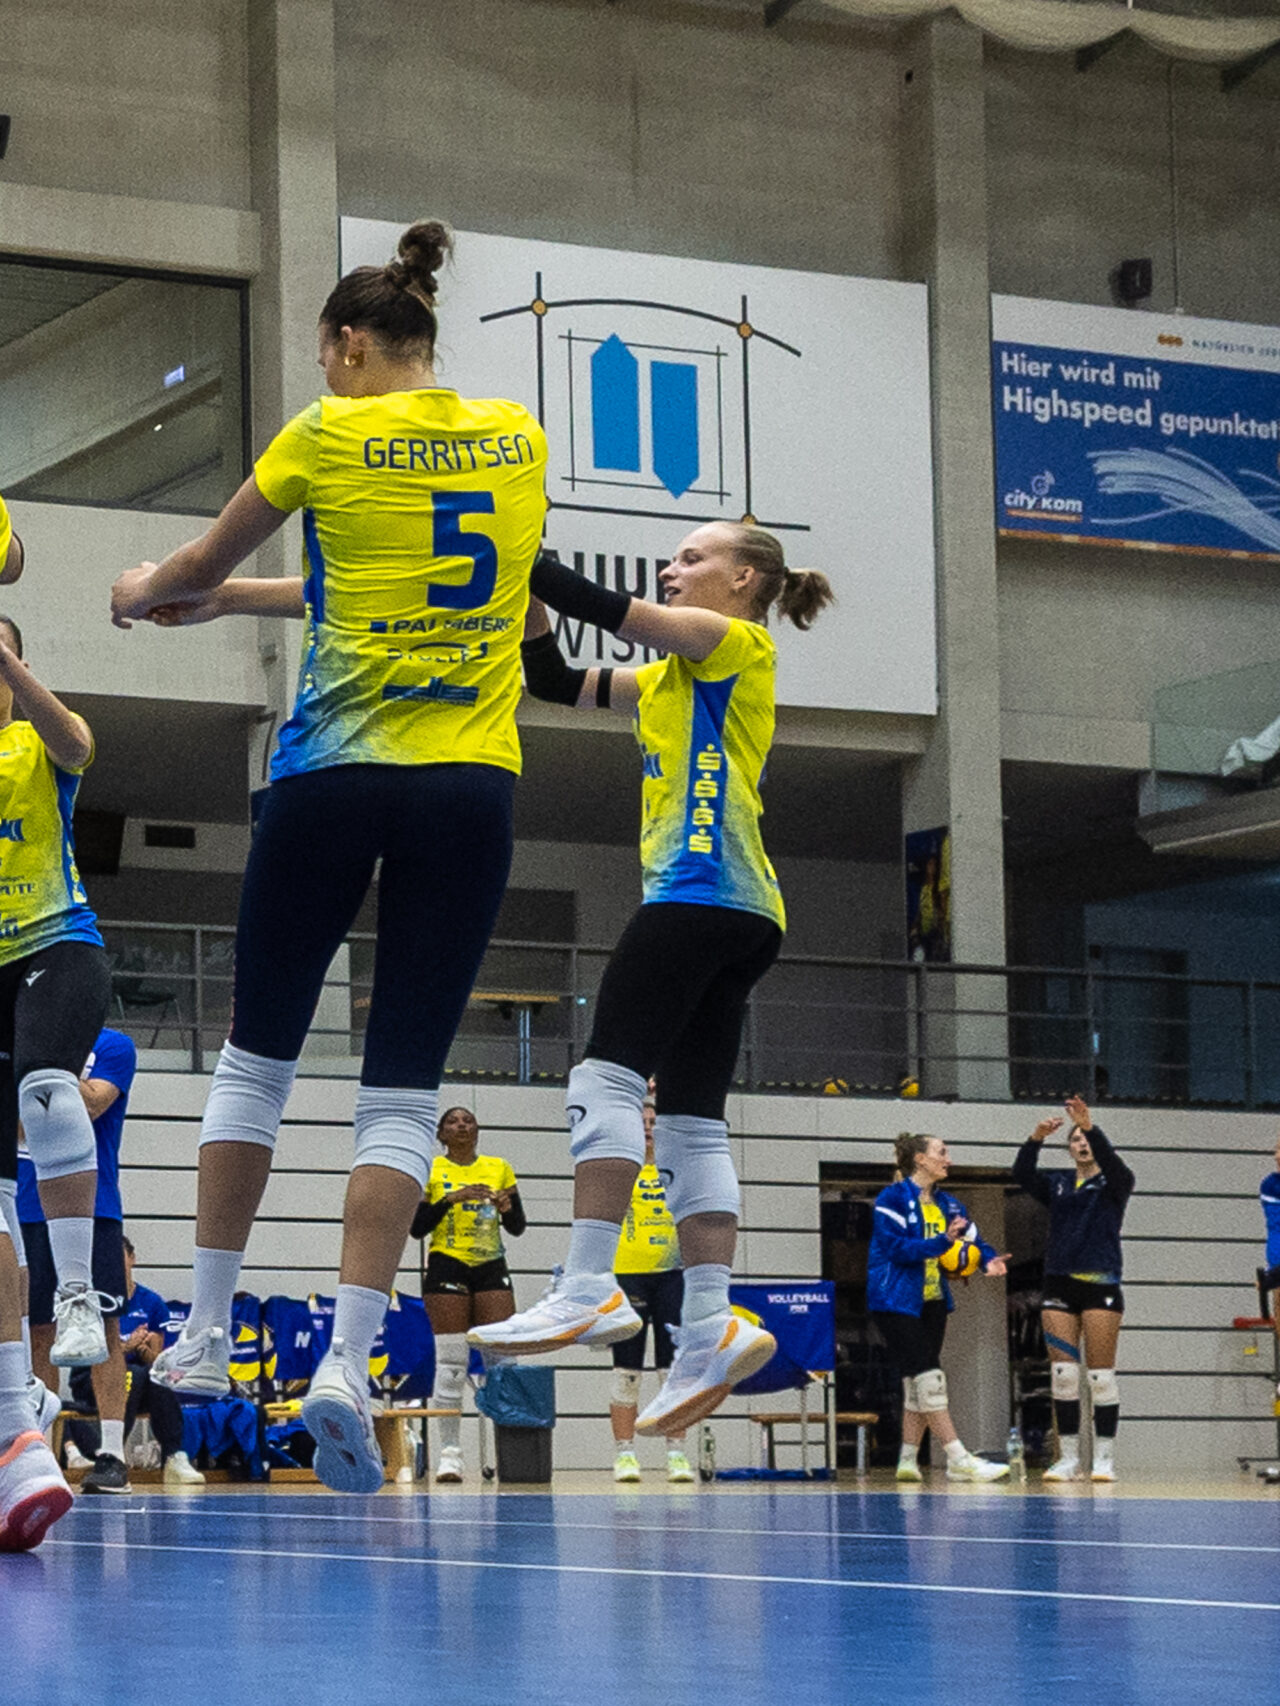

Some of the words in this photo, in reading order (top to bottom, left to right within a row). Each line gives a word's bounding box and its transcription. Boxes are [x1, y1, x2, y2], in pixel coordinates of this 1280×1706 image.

[1001, 351, 1052, 378] Hier
[1059, 359, 1116, 386] wird
[1123, 366, 1162, 390] mit
[1003, 385, 1152, 428] Highspeed
[364, 434, 534, 470] GERRITSEN
[426, 490, 498, 611] 5
[767, 1293, 830, 1304] VOLLEYBALL
